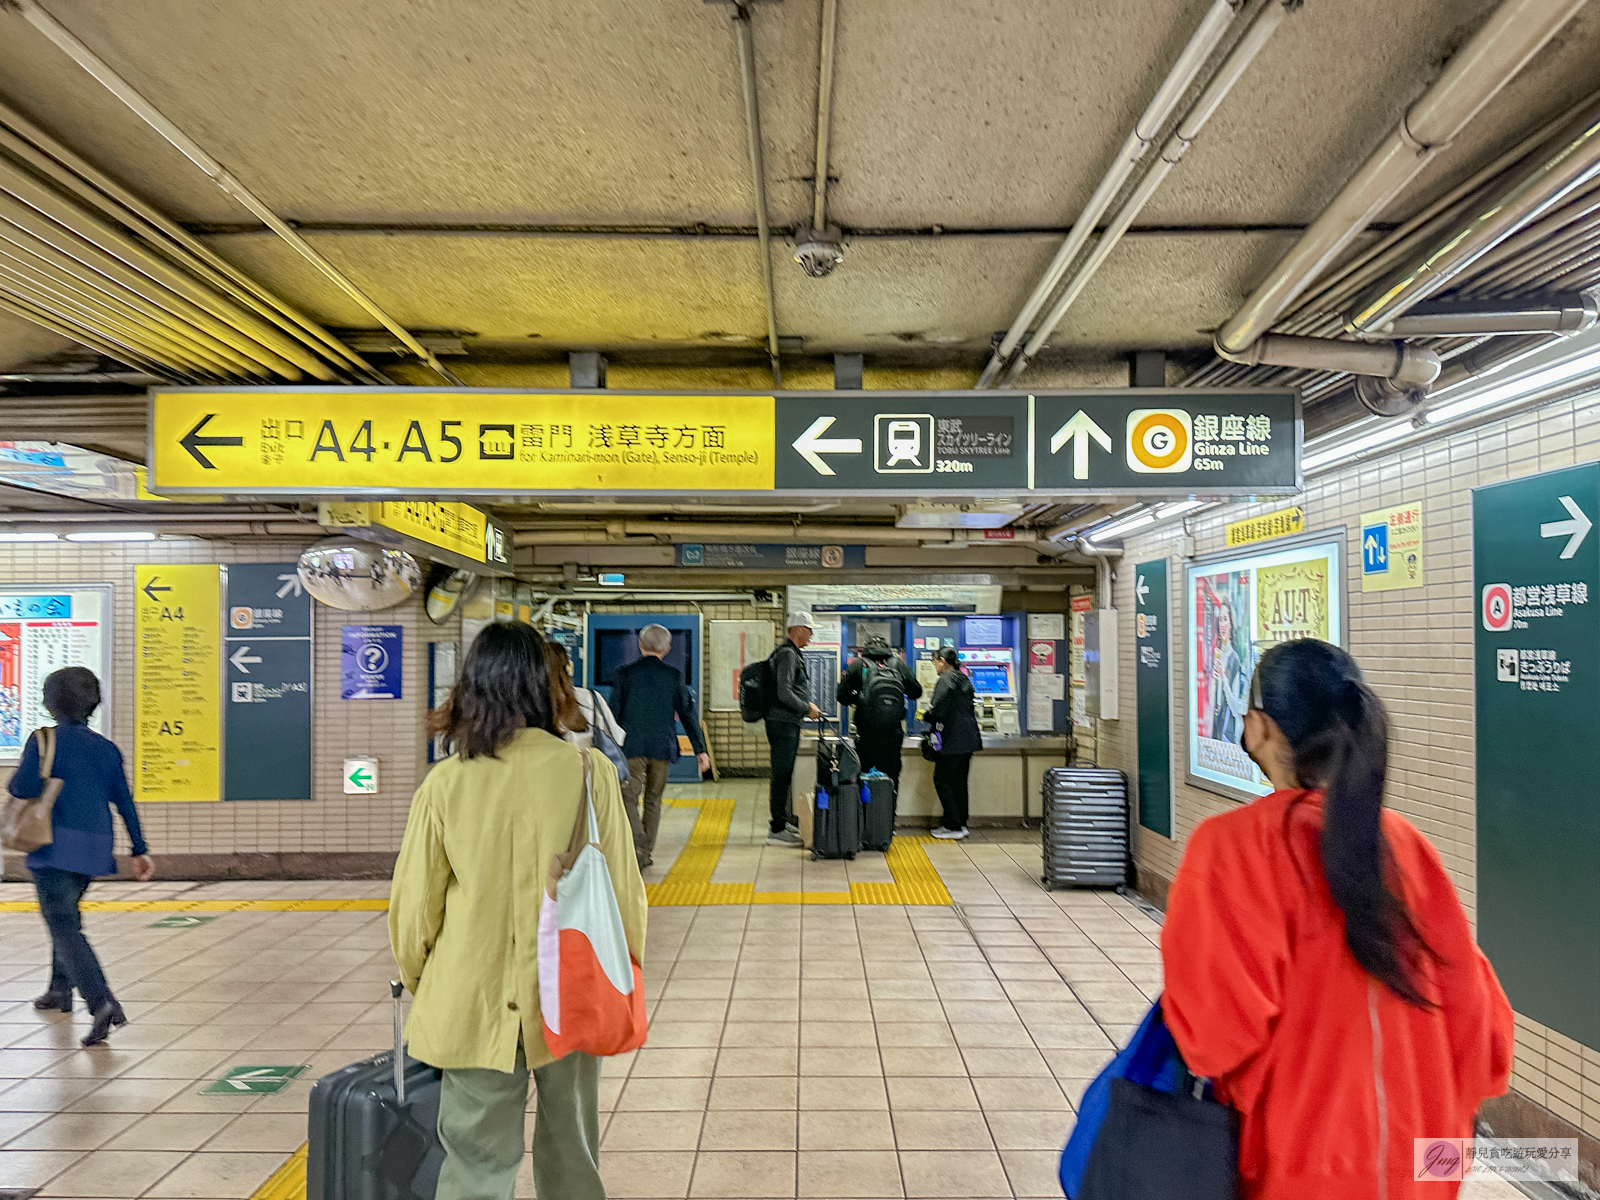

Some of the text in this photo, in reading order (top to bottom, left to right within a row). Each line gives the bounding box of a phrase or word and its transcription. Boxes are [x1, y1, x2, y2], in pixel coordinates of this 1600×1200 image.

[1194, 414, 1272, 442] 銀座線
[520, 423, 727, 449] 雷門 浅草寺方面
[937, 432, 1013, 447] スカイツリーライン
[1151, 432, 1168, 450] G
[1194, 442, 1270, 456] Ginza Line
[520, 451, 535, 463] for
[540, 450, 620, 463] Kaminari-mon
[663, 451, 706, 466] Senso-ji
[709, 451, 759, 466] (Temple)
[1194, 458, 1225, 471] 65m
[935, 460, 974, 473] 320m
[1513, 581, 1588, 607] 都営浅草線
[159, 607, 185, 622] A4
[1492, 600, 1503, 615] A
[1513, 605, 1564, 618] Asakusa Line
[158, 720, 185, 736] A5
